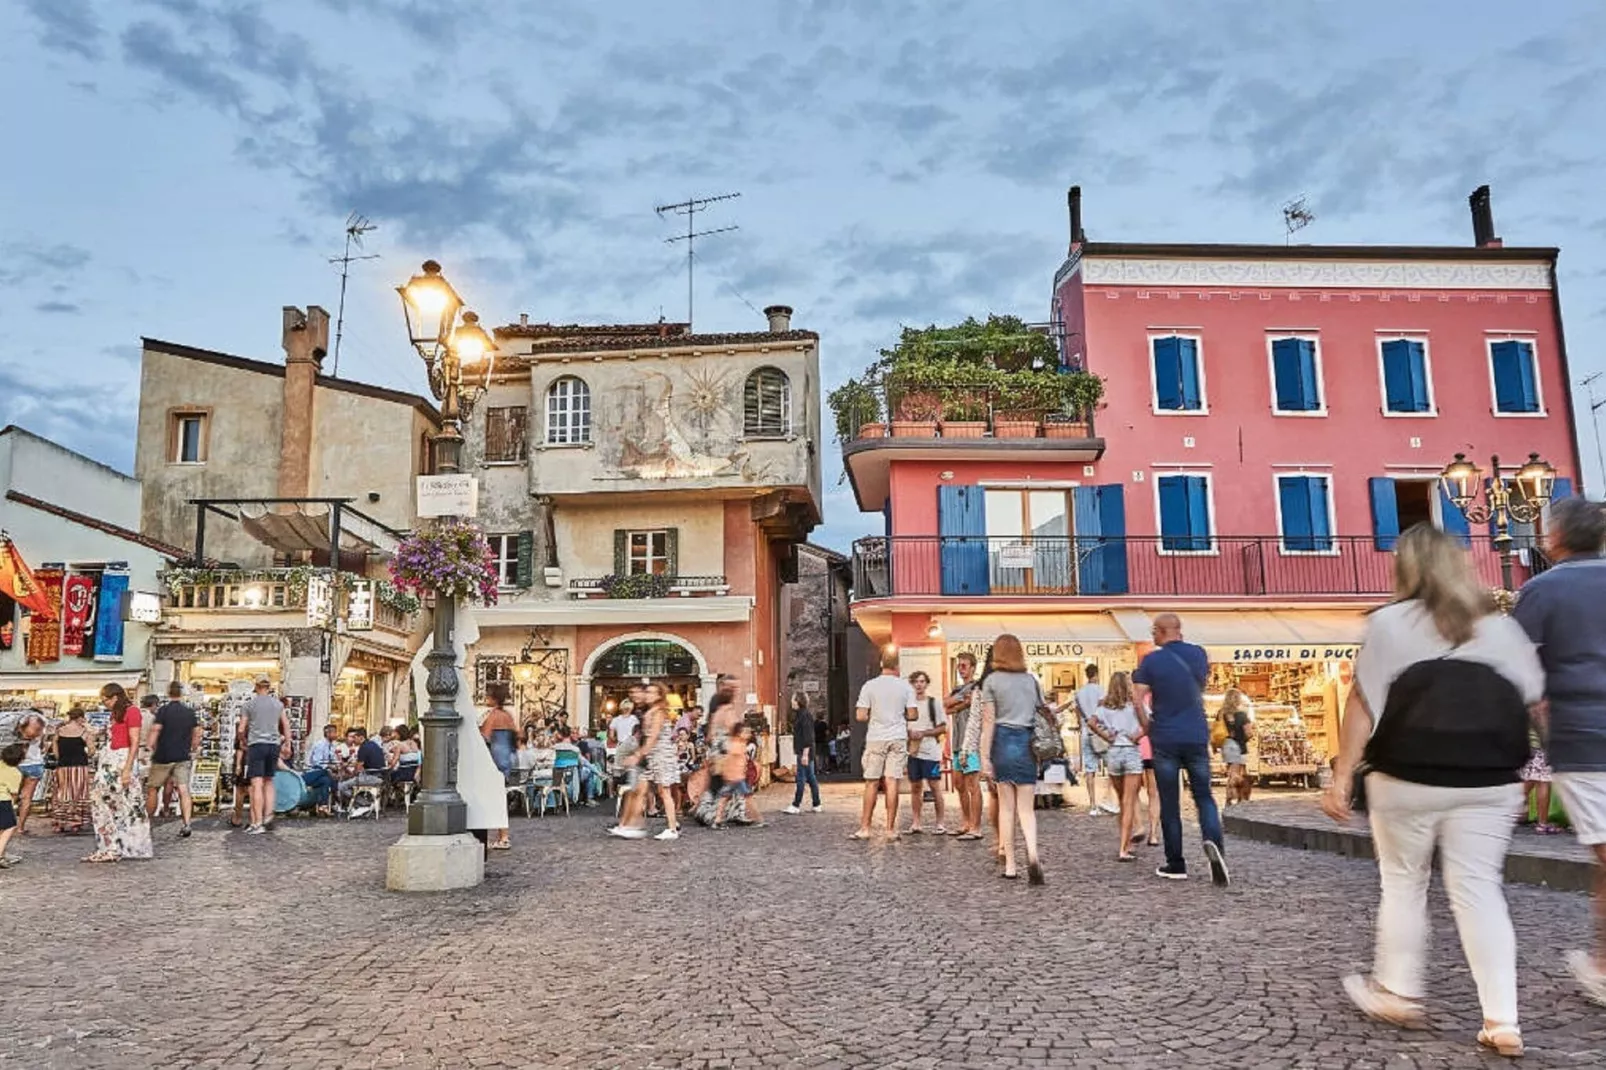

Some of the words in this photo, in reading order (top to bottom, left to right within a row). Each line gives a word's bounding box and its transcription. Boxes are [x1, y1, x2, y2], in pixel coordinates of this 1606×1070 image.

[1026, 643, 1083, 656] GELATO
[1234, 648, 1290, 660] SAPORI
[1300, 648, 1316, 659] DI
